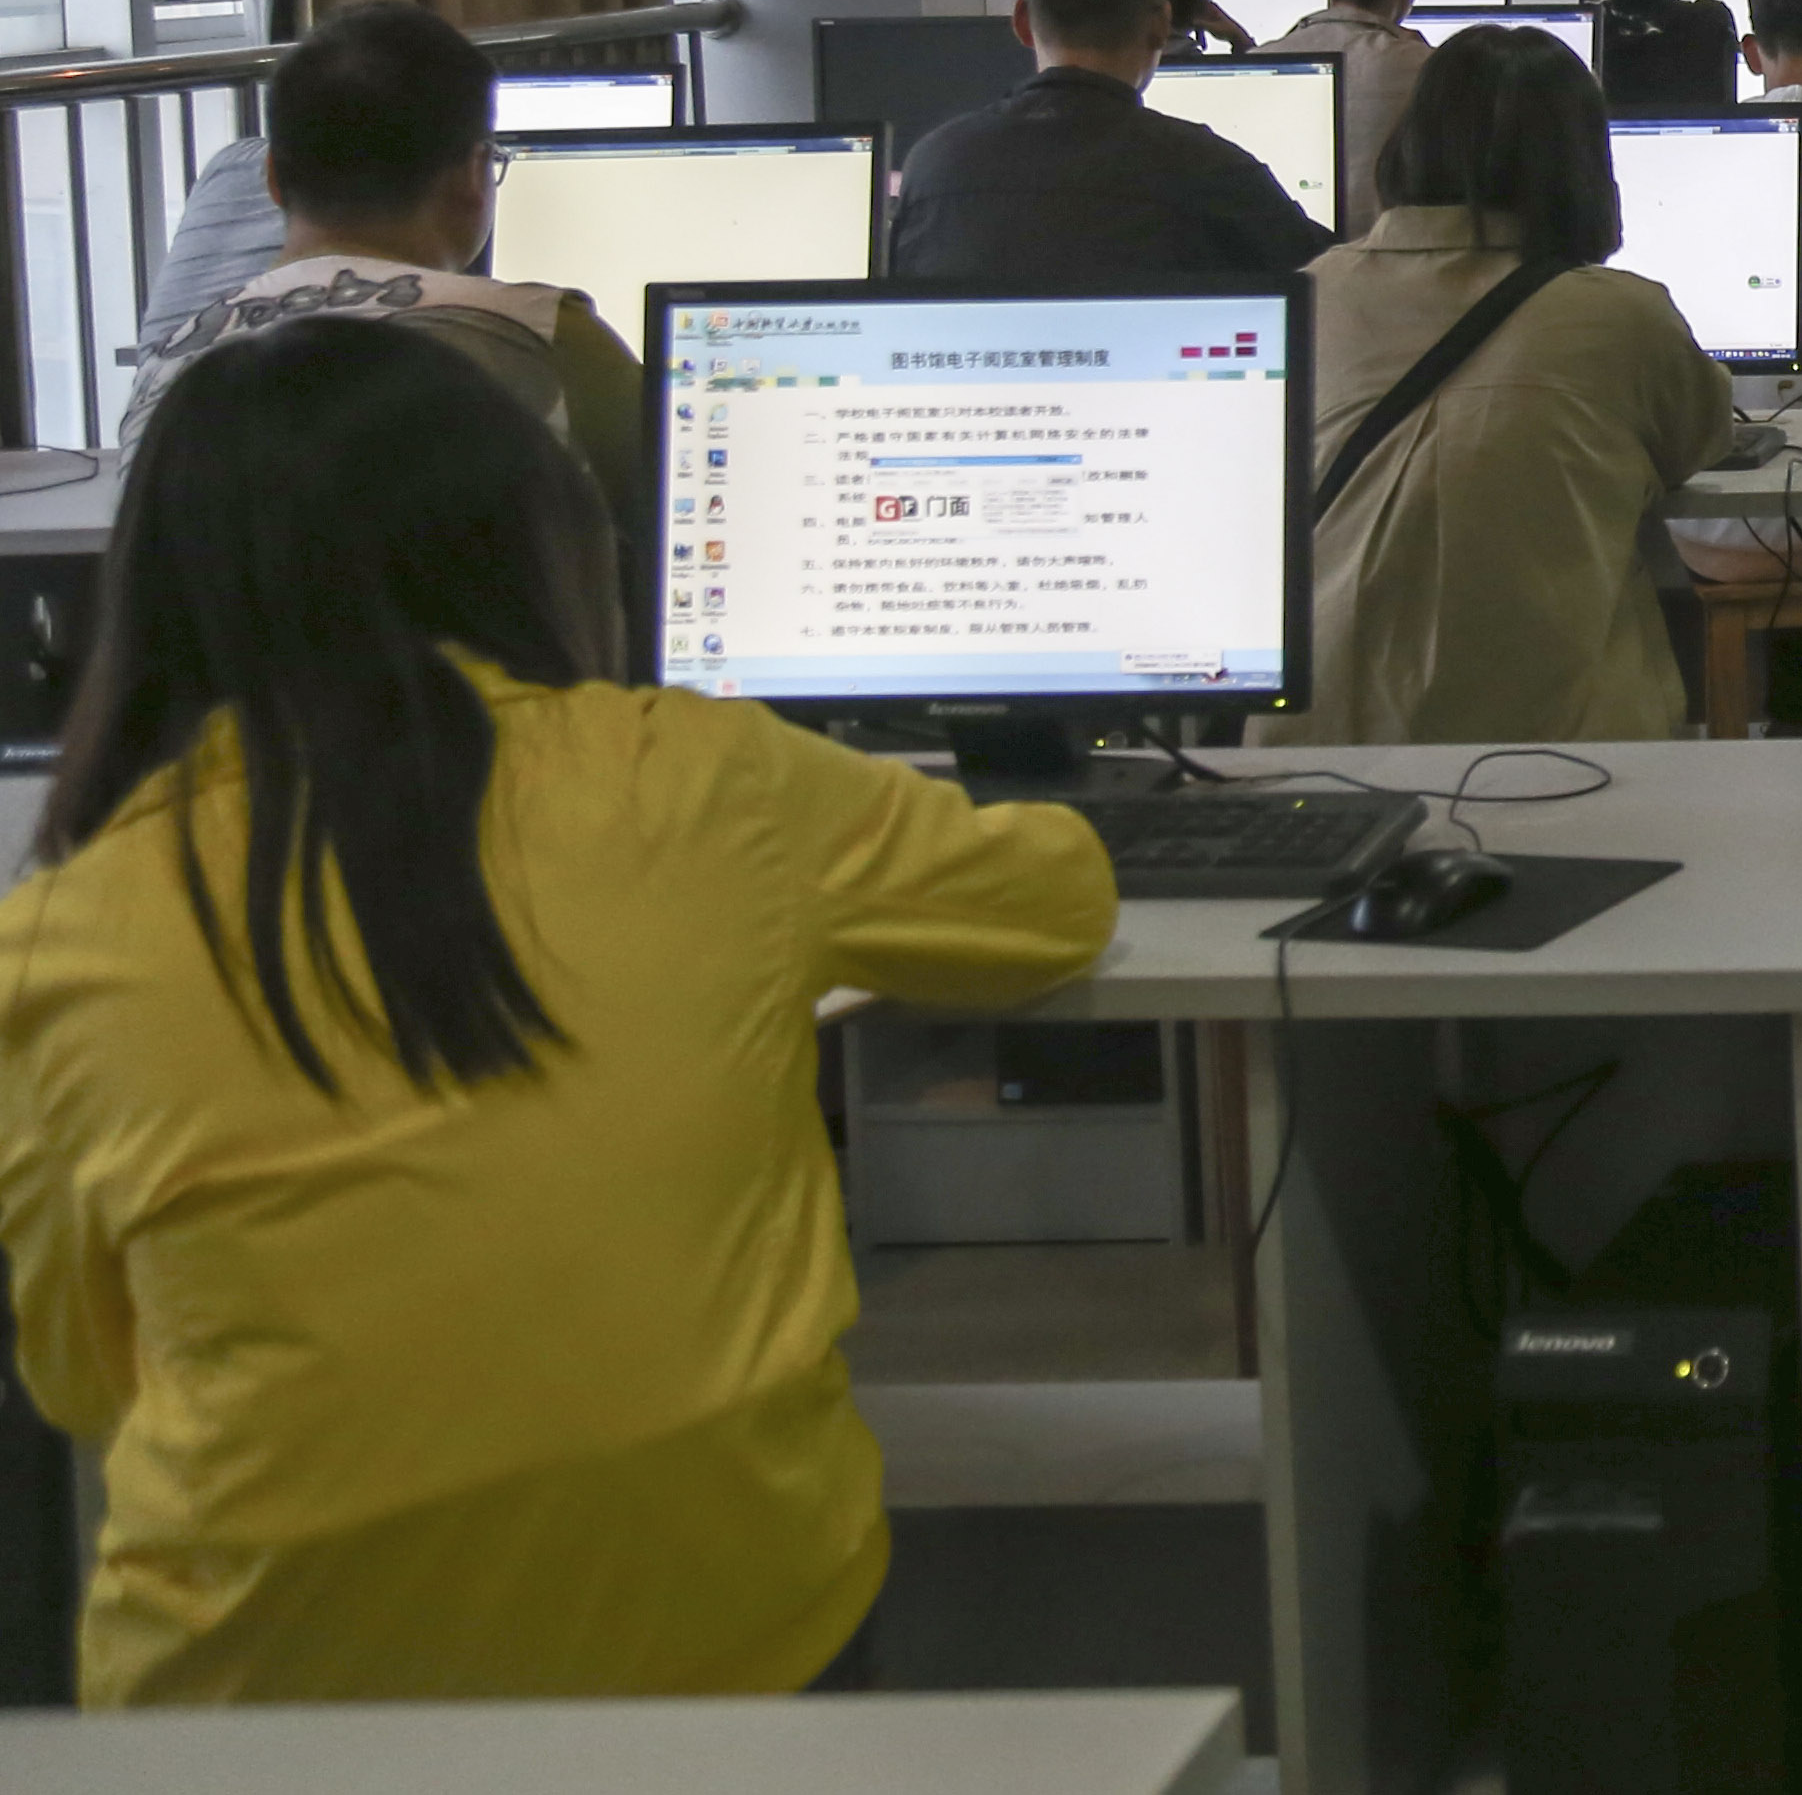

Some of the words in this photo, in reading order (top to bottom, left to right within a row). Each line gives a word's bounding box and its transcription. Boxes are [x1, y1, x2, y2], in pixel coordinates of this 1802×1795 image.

[891, 348, 1111, 370] 图书馆电子阅览室管理制度
[926, 495, 971, 517] 门面
[1518, 1329, 1616, 1352] lenovo
